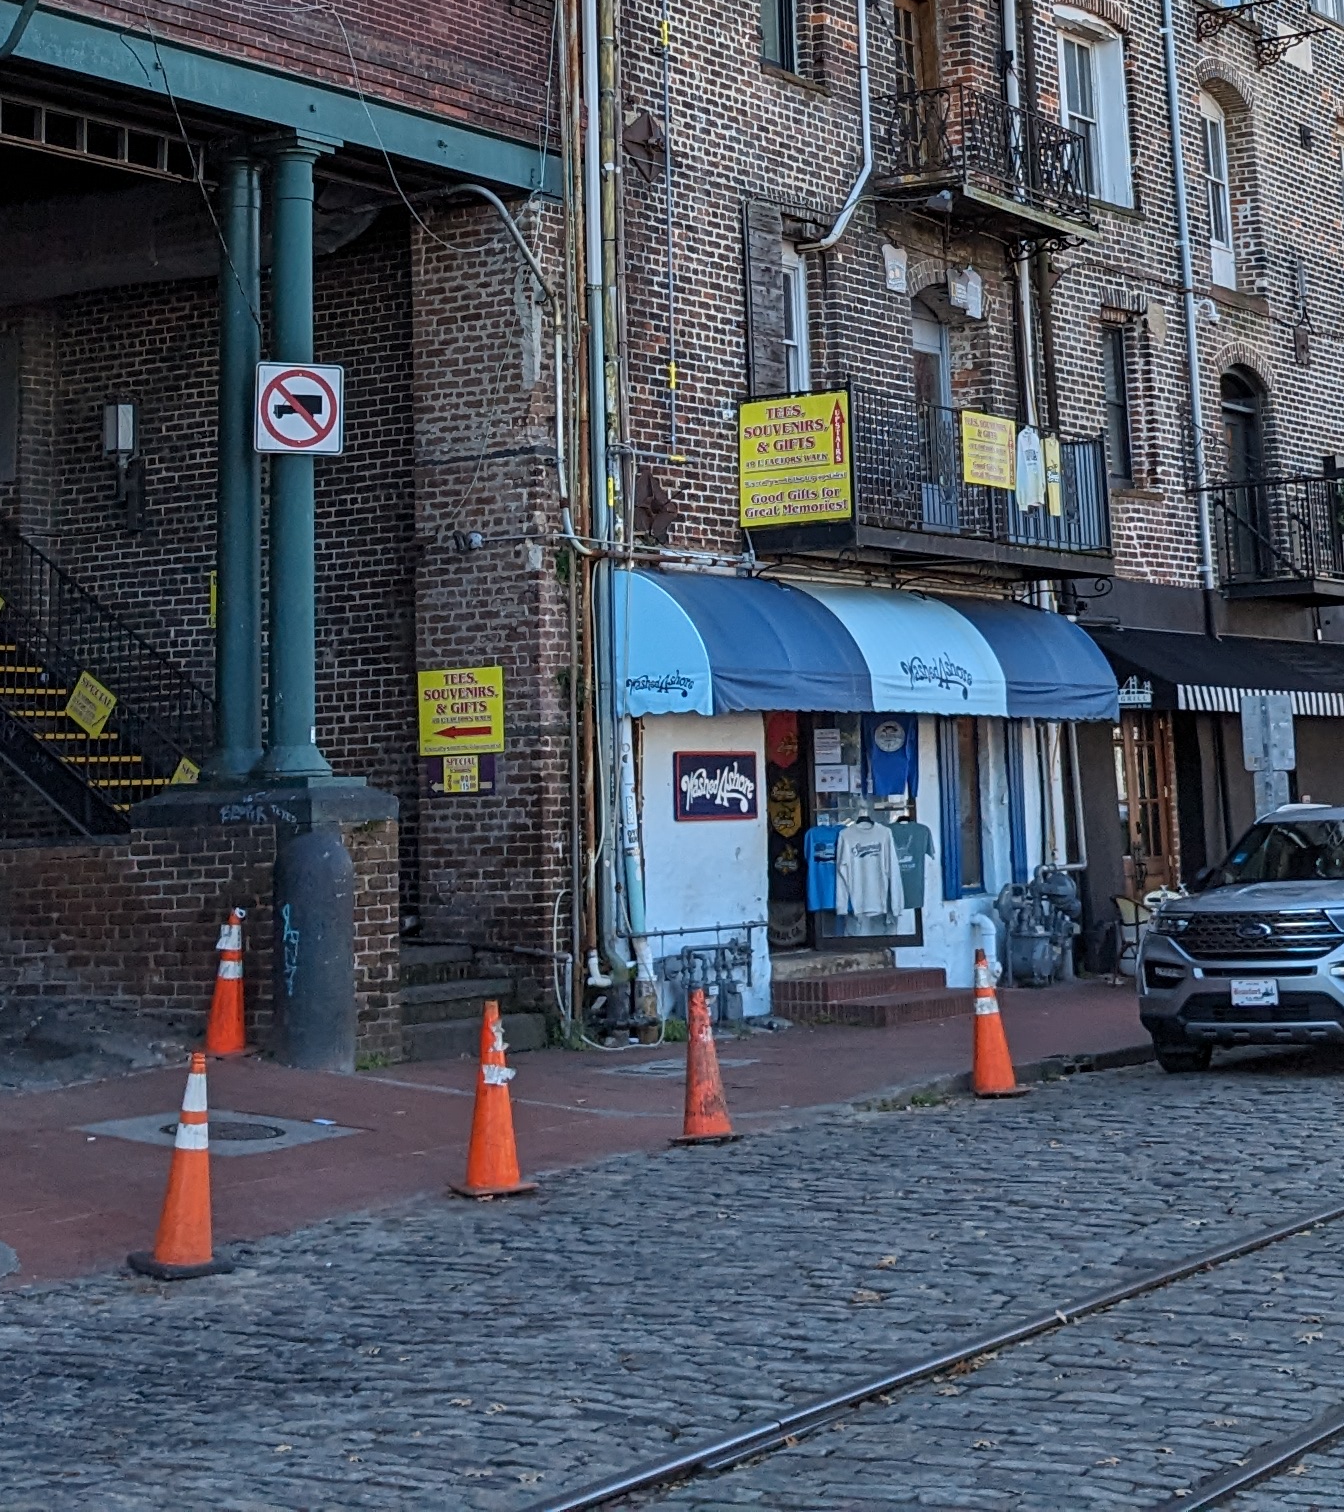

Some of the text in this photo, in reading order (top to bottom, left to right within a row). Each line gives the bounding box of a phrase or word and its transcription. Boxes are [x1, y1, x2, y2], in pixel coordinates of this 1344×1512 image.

[744, 418, 830, 440] SOUVENIRS,
[834, 409, 842, 462] UPSTAIRS
[756, 436, 816, 454] & GIFTS
[751, 486, 842, 505] Good Gifts for
[745, 505, 780, 520] Great
[626, 669, 695, 698] Washed Ashore
[900, 652, 973, 700] Washed Ashore
[436, 701, 487, 715] & GIFTS
[445, 756, 476, 766] SPECIAL
[681, 761, 755, 813] Washed Ashore
